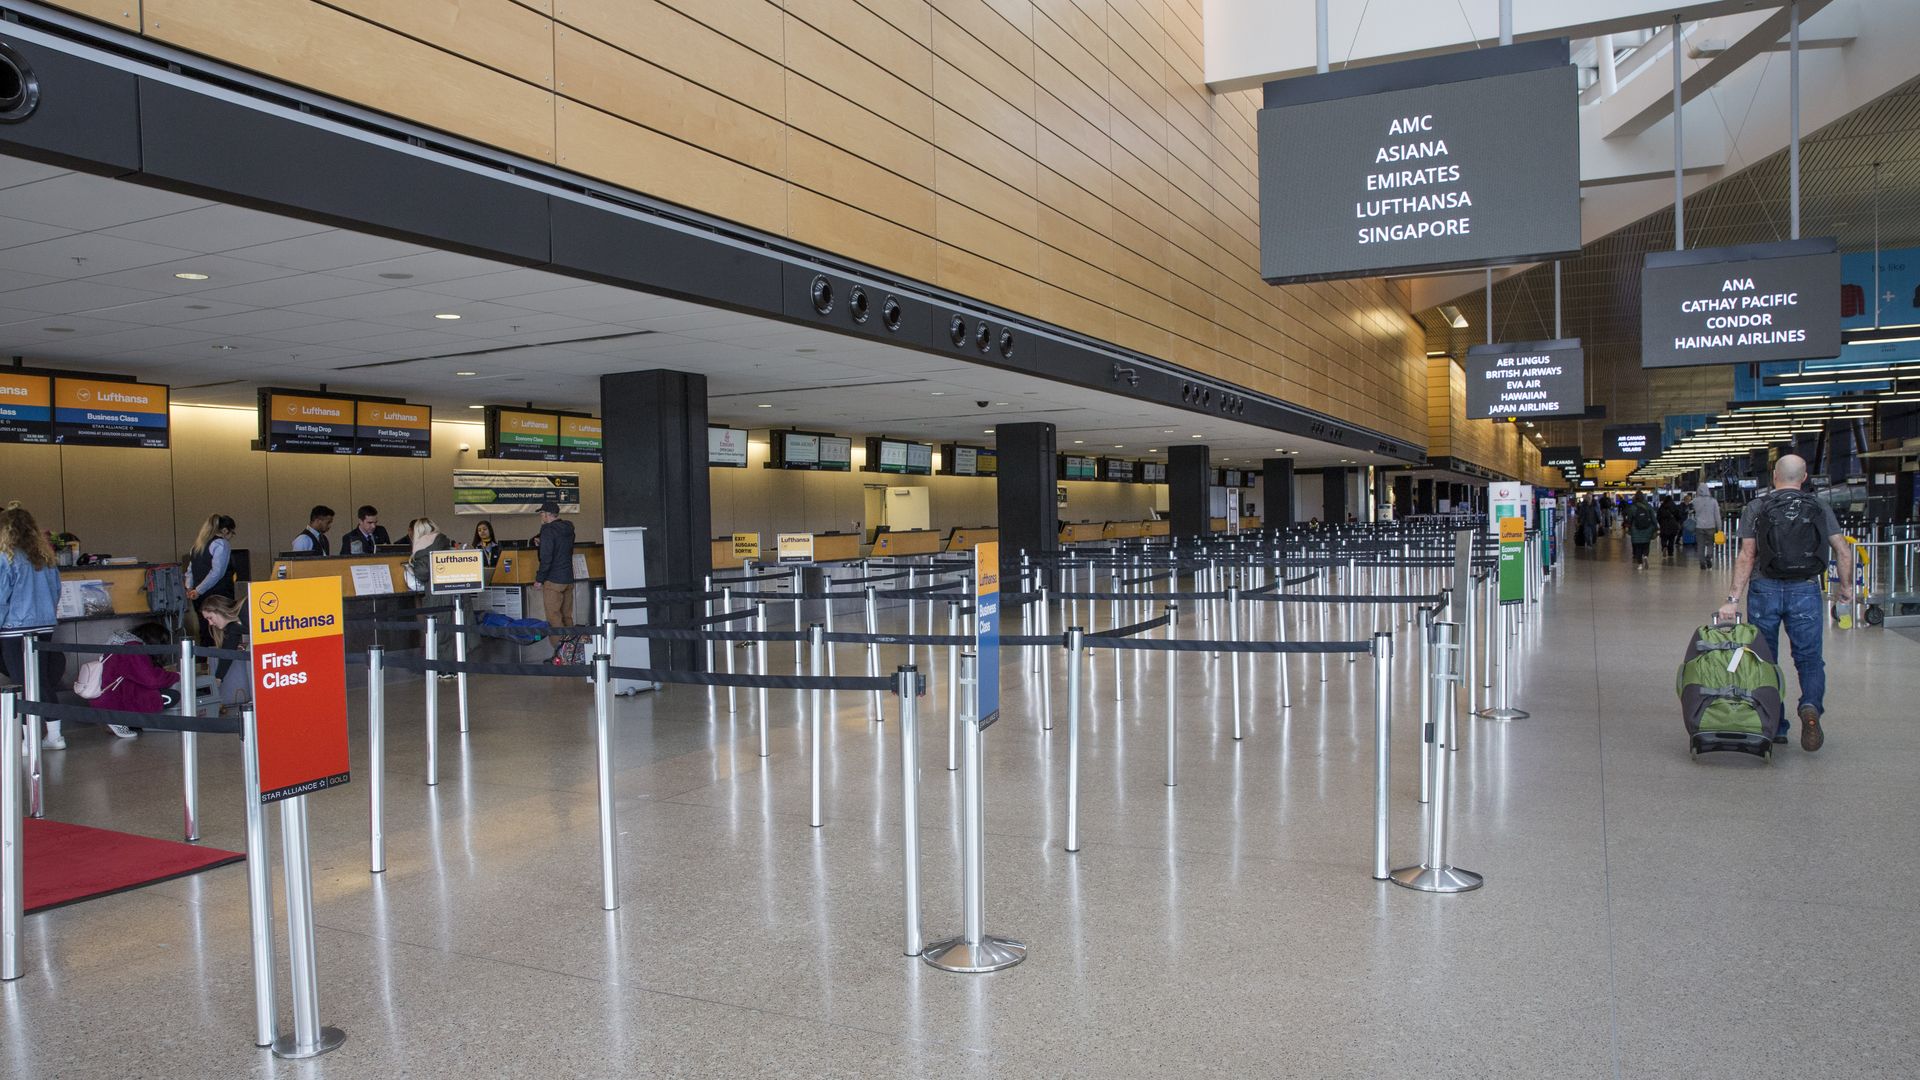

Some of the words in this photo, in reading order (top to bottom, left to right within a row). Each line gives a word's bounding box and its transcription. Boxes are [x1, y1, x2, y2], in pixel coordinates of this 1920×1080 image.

[1388, 114, 1433, 136] AMC
[1375, 139, 1449, 164] ASIANA
[1366, 164, 1461, 191] EMIRATES
[1356, 191, 1472, 218] LUFTHANSA
[1358, 217, 1470, 244] SINGAPORE
[1721, 277, 1756, 292] ANA
[1681, 297, 1738, 313] CATHAY
[1741, 292, 1798, 309] PACIFIC
[1706, 313, 1773, 330] CONDOR
[1674, 334, 1733, 350] HAINAN
[1736, 329, 1806, 346] AIRLINES
[1496, 357, 1514, 367] AER
[1516, 355, 1550, 366] LINGUS
[1485, 369, 1521, 379] BRITISH
[1521, 366, 1562, 377] AIRWAYS
[1506, 380, 1524, 390] EVA
[1525, 379, 1541, 388] AIR
[97, 391, 149, 404] Lufthansa
[1500, 391, 1547, 401] HAWAIIAN
[302, 406, 341, 417] Lufthansa
[1488, 404, 1517, 415] JAPAN
[1518, 402, 1560, 412] AIRLINES
[87, 412, 119, 422] Business
[119, 414, 139, 423] Class
[383, 411, 418, 422] Lufthansa
[307, 426, 318, 434] Bag
[318, 426, 332, 434] Drop
[521, 420, 548, 429] Lufthansa
[435, 555, 478, 564] Lufthansa
[1501, 553, 1514, 561] Class
[979, 573, 998, 587] Lufthansa
[979, 602, 997, 618] Business
[260, 614, 335, 633] Lufthansa
[979, 620, 991, 635] Class
[261, 650, 298, 670] First
[262, 671, 308, 689] Class
[261, 791, 281, 802] STAR
[282, 781, 318, 797] ALLIANCE
[329, 775, 348, 785] GOLD
